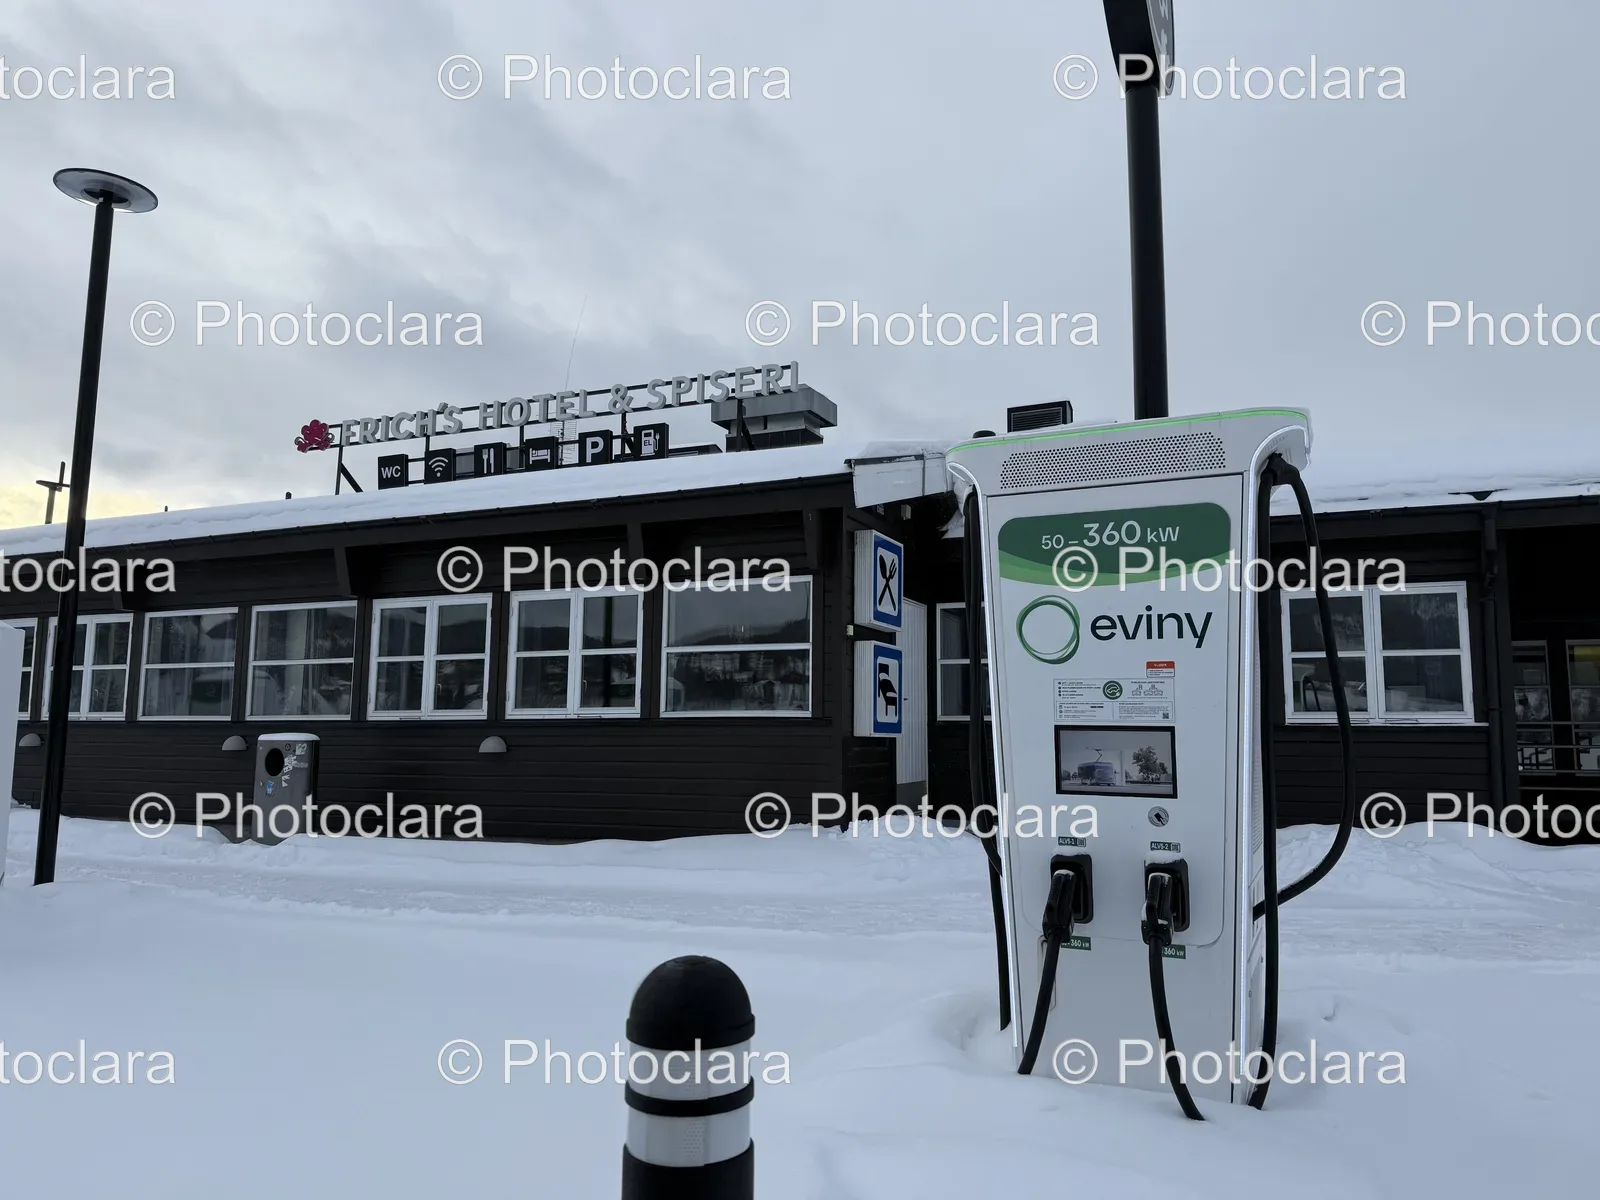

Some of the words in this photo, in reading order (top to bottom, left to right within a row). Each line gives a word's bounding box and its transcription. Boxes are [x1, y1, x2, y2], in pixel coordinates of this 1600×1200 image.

[342, 402, 463, 446] FRICH'S
[479, 389, 596, 430] HOTEL
[608, 384, 634, 414] &
[647, 361, 799, 410] SPISERI
[586, 436, 604, 462] P
[381, 465, 401, 478] WC
[1147, 526, 1180, 543] kW
[1090, 605, 1213, 649] eviny
